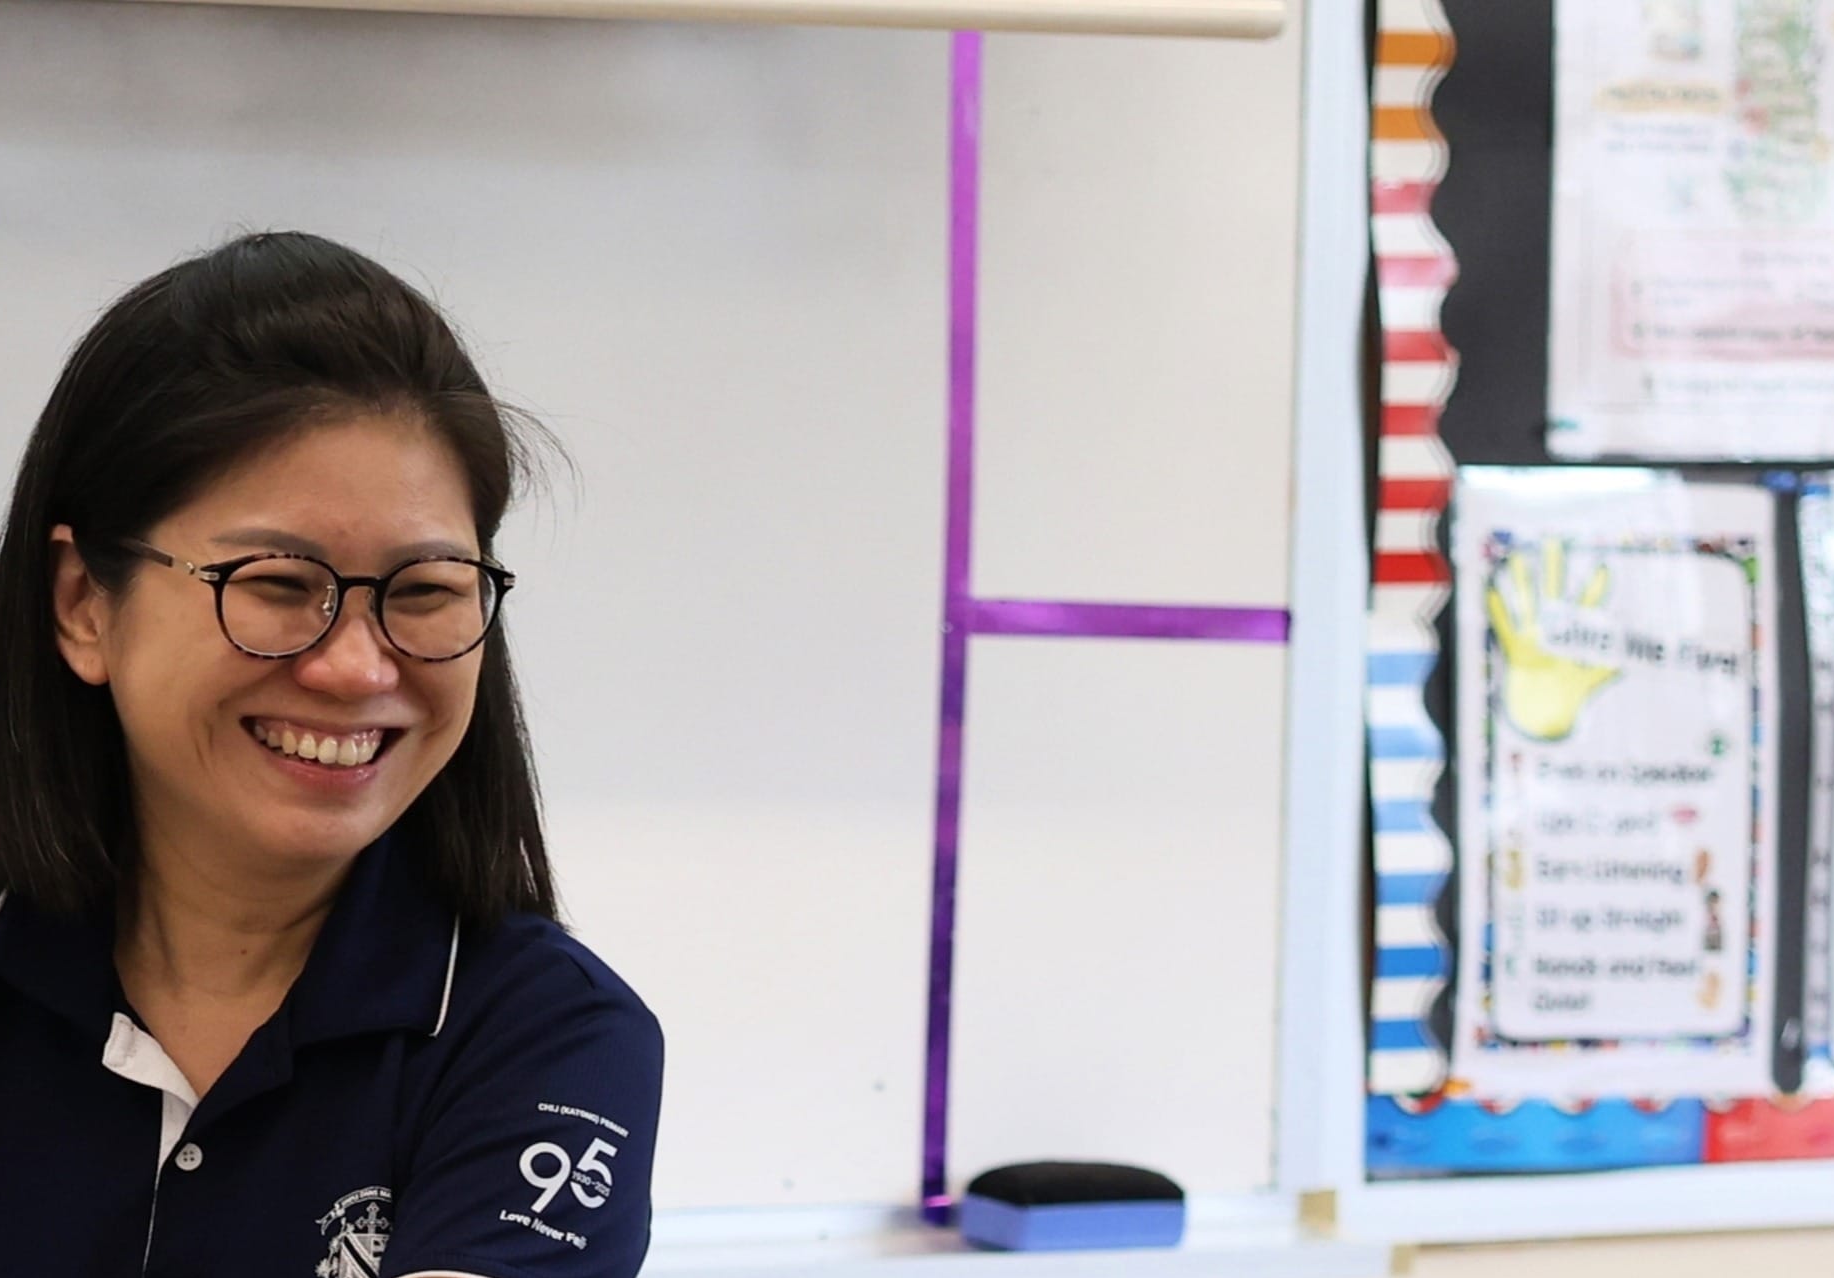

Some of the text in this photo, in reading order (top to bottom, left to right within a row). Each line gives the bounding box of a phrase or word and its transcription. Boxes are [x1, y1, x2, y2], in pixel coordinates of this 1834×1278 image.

[519, 1137, 618, 1213] 95
[499, 1210, 531, 1226] Love
[531, 1218, 564, 1241] Never
